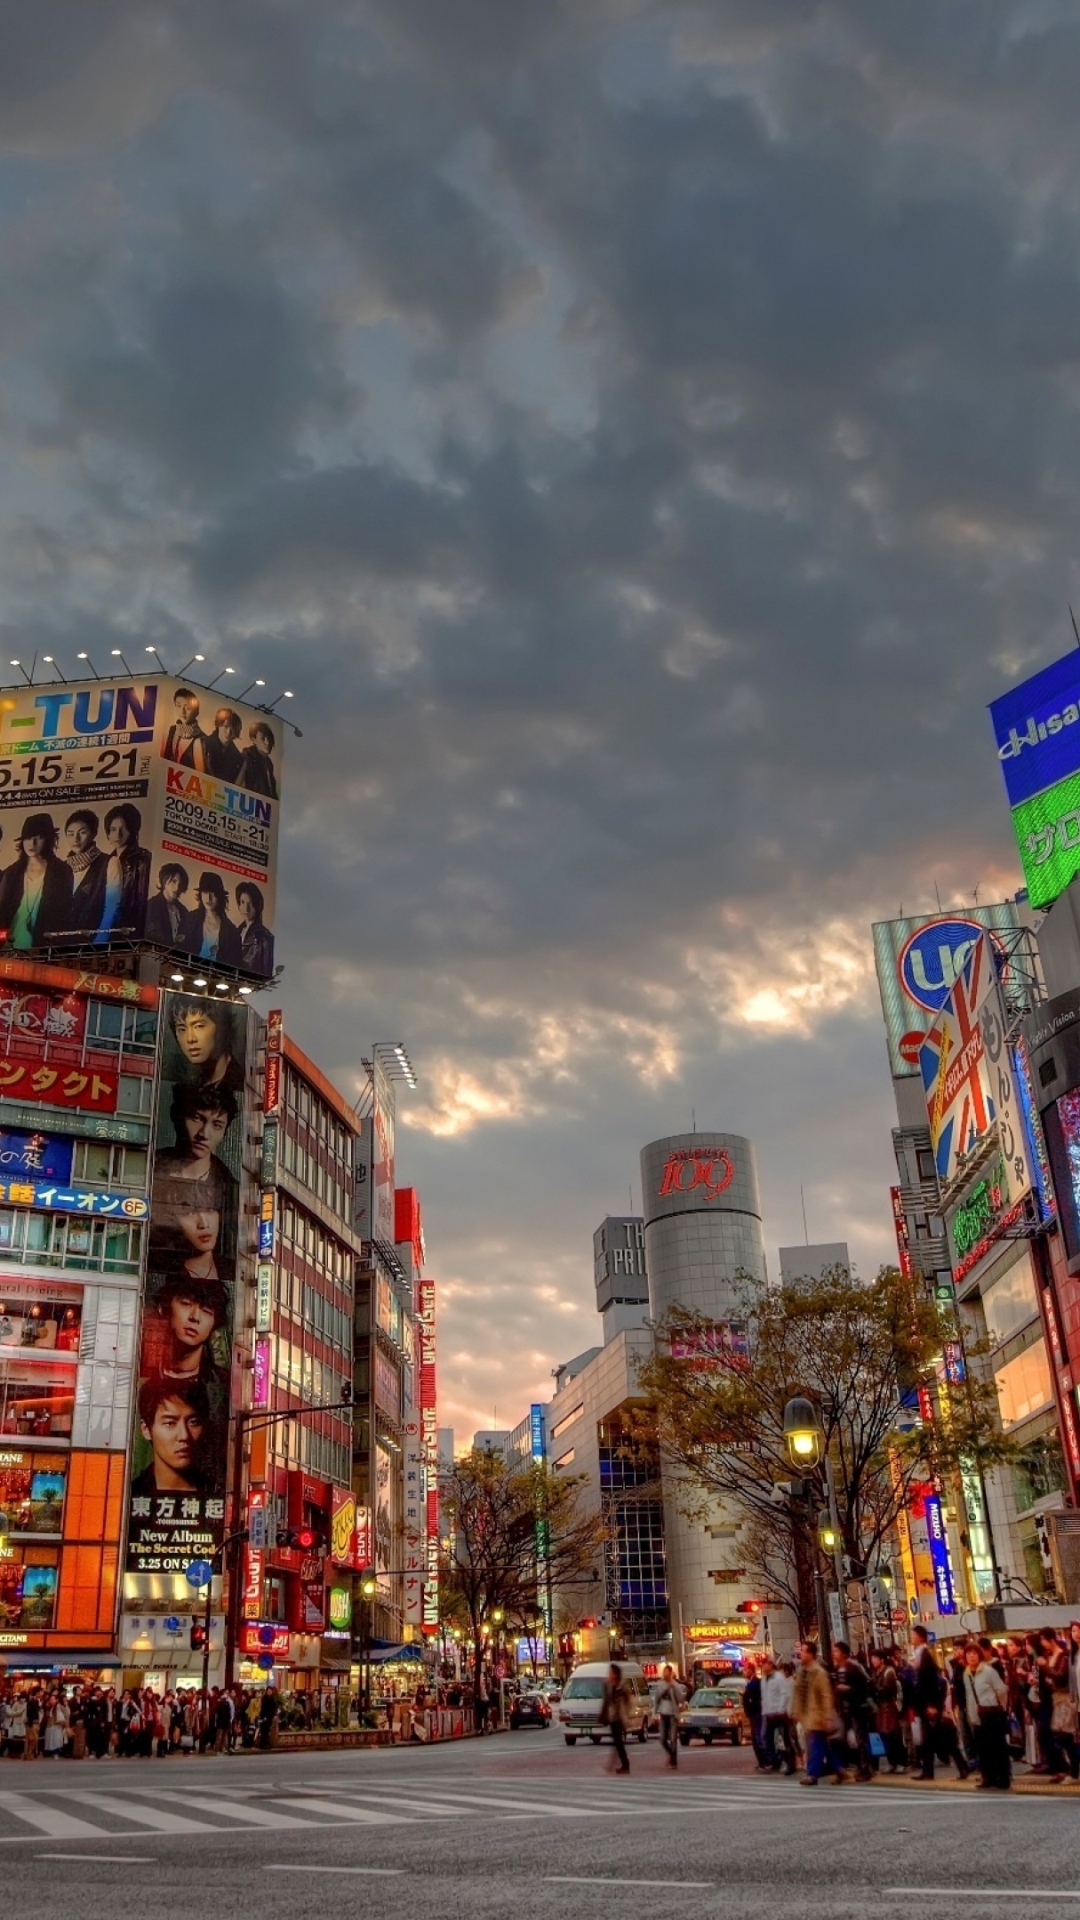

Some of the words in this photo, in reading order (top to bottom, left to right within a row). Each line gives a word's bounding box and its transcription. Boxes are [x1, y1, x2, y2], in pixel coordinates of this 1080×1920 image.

[998, 699, 1080, 760] Hisa
[55, 786, 81, 796] SALE
[166, 766, 272, 823] KAT-TUN
[165, 796, 237, 832] 2009.5.15
[165, 809, 194, 824] TOKYO
[195, 820, 219, 834] DOME
[659, 1157, 735, 1200] 109
[124, 1200, 144, 1213] 6F
[131, 1496, 224, 1519] 東方神起
[929, 1503, 942, 1539] MIZUHO
[139, 1529, 169, 1542] New
[171, 1529, 213, 1543] Album
[129, 1542, 152, 1553] The
[153, 1543, 192, 1554] Secret
[192, 1544, 221, 1555] Cod
[138, 1558, 161, 1570] 3.25
[162, 1559, 181, 1570] ON
[406, 1535, 418, 1609] マルナン
[689, 1626, 727, 1637] SPRING
[728, 1625, 751, 1636] FAIR
